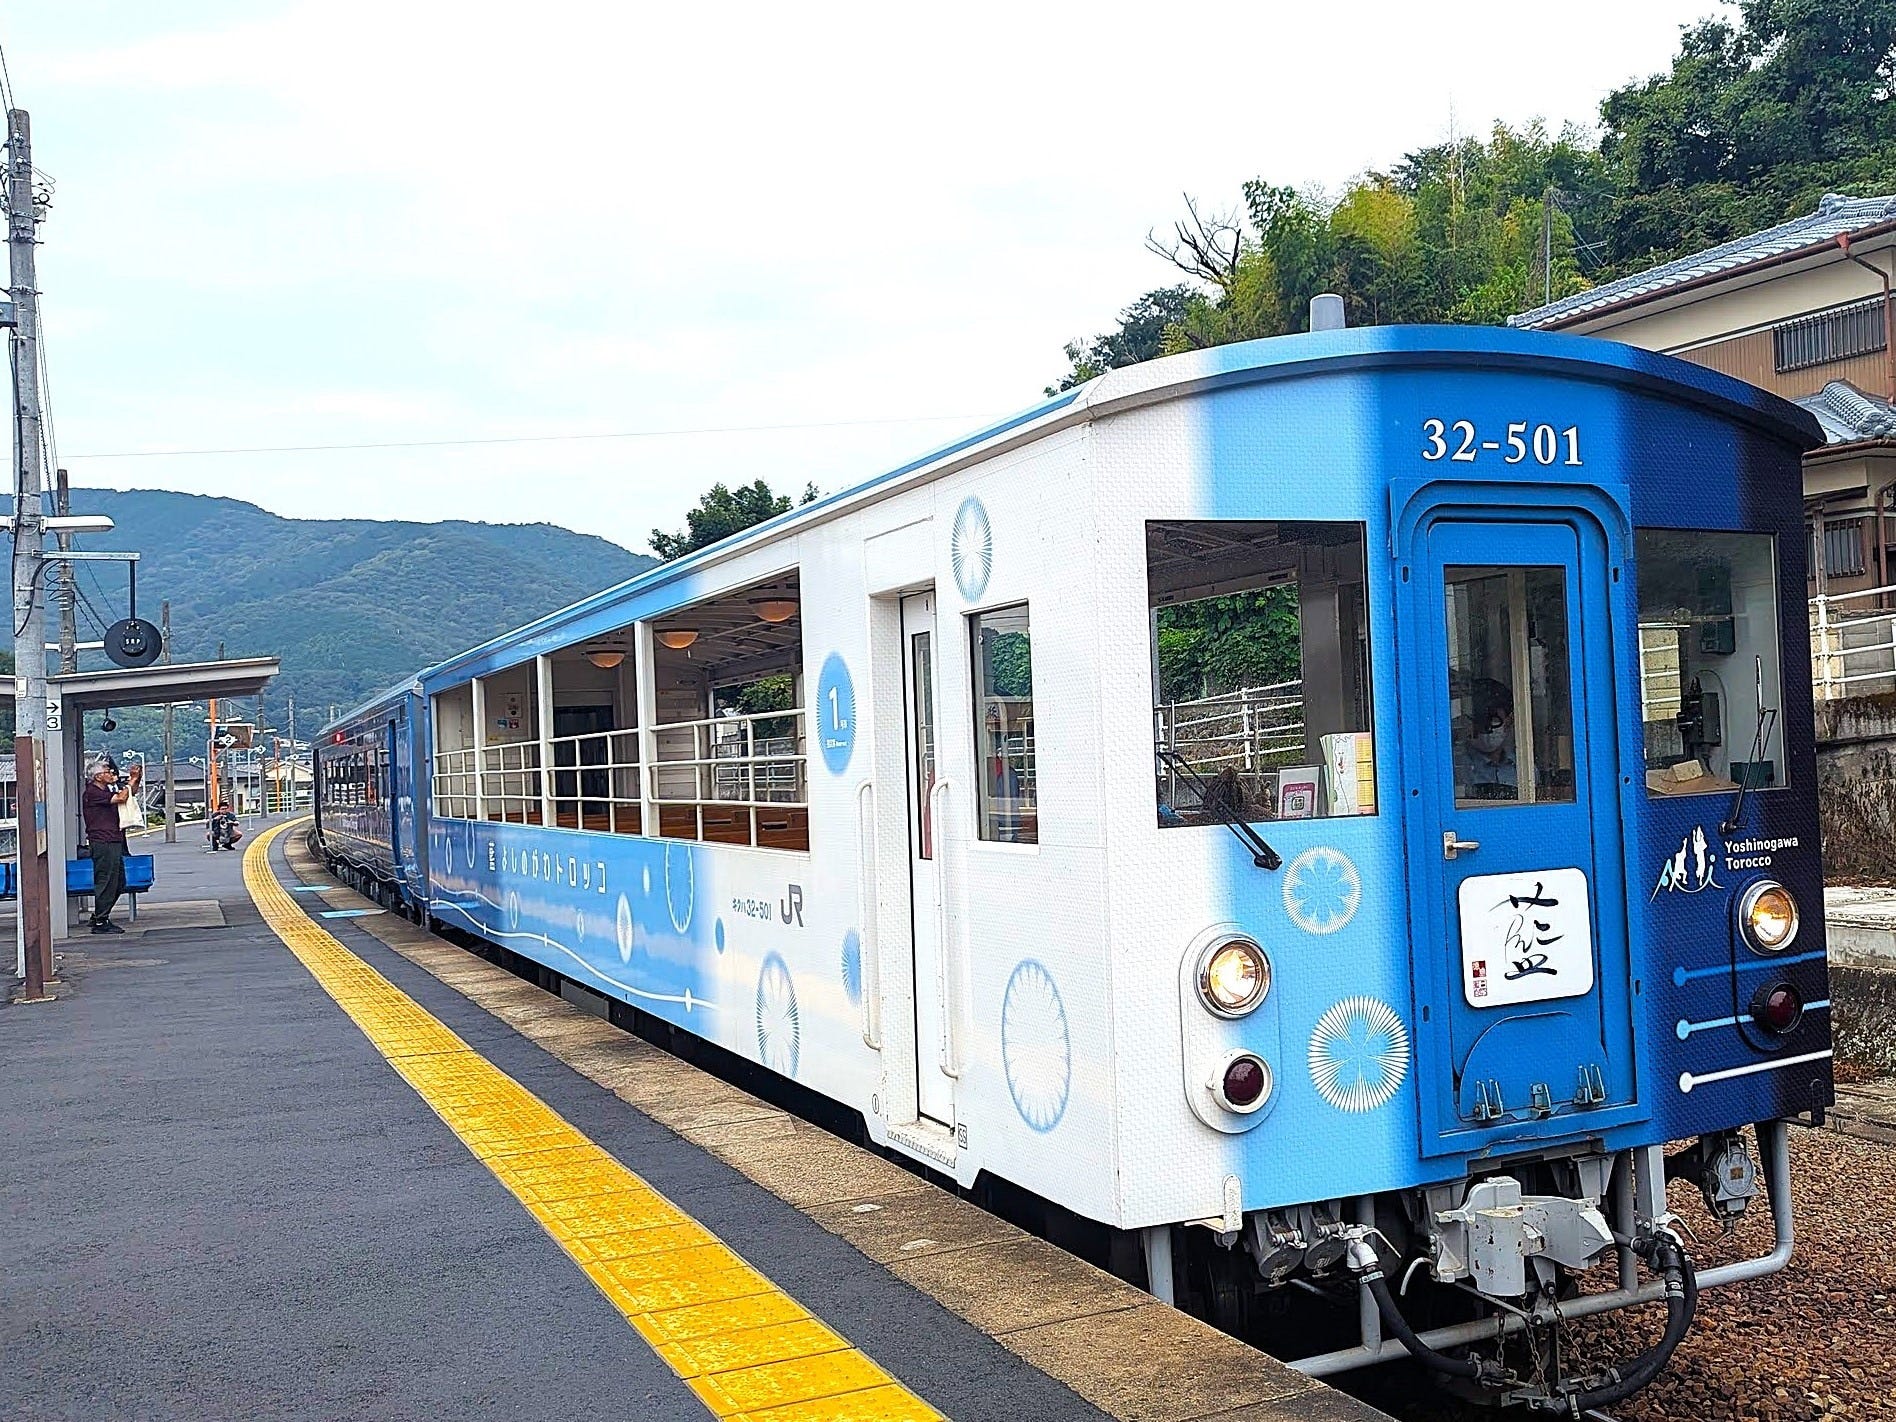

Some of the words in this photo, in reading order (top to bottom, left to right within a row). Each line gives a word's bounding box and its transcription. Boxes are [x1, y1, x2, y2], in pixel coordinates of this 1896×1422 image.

[1422, 417, 1583, 466] 32-501
[47, 717, 59, 729] 3
[828, 686, 839, 731] 1
[1725, 836, 1799, 854] Yoshinogawa
[1725, 855, 1772, 870] Torocco
[780, 884, 804, 927] JR
